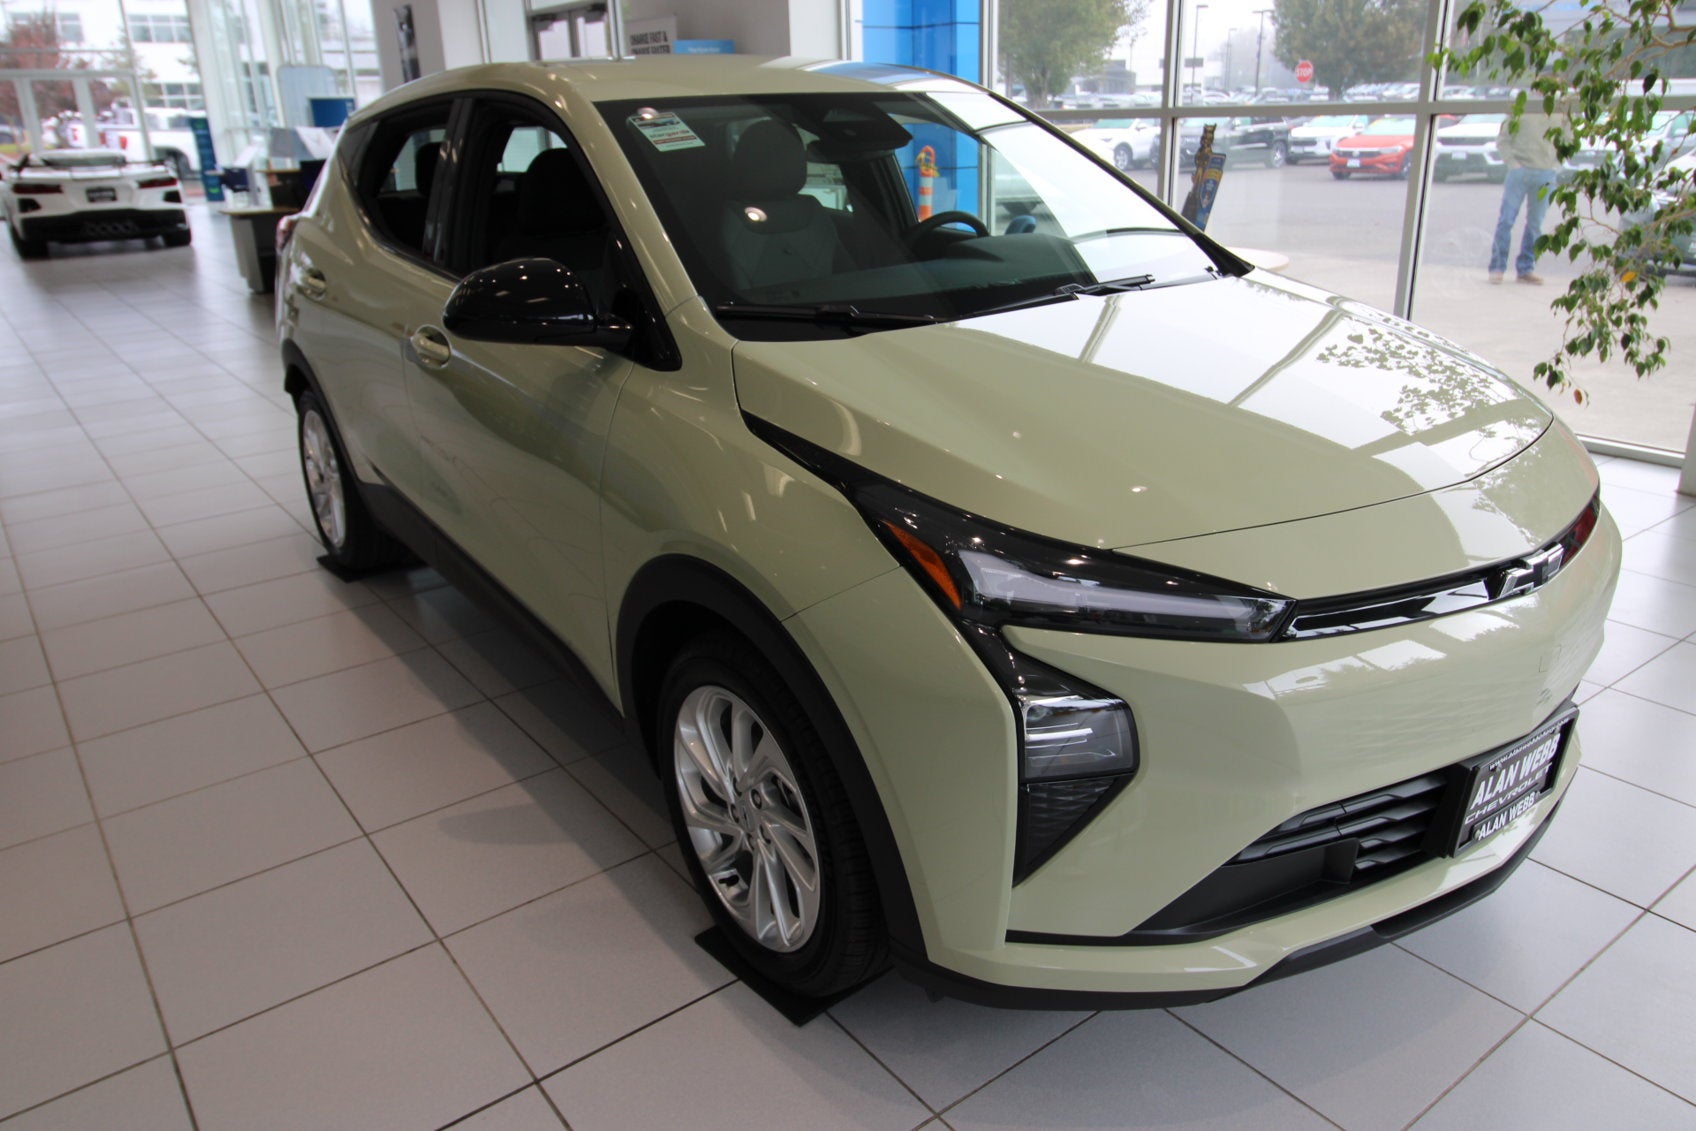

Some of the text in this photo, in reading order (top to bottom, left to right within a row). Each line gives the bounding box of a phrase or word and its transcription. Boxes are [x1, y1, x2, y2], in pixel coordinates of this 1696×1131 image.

[1296, 67, 1313, 77] STOP
[1465, 762, 1553, 825] CHEVROLET
[1470, 760, 1520, 810] ALAN
[1519, 733, 1561, 780] WEBB
[1478, 792, 1536, 841] ALAN WEBB
